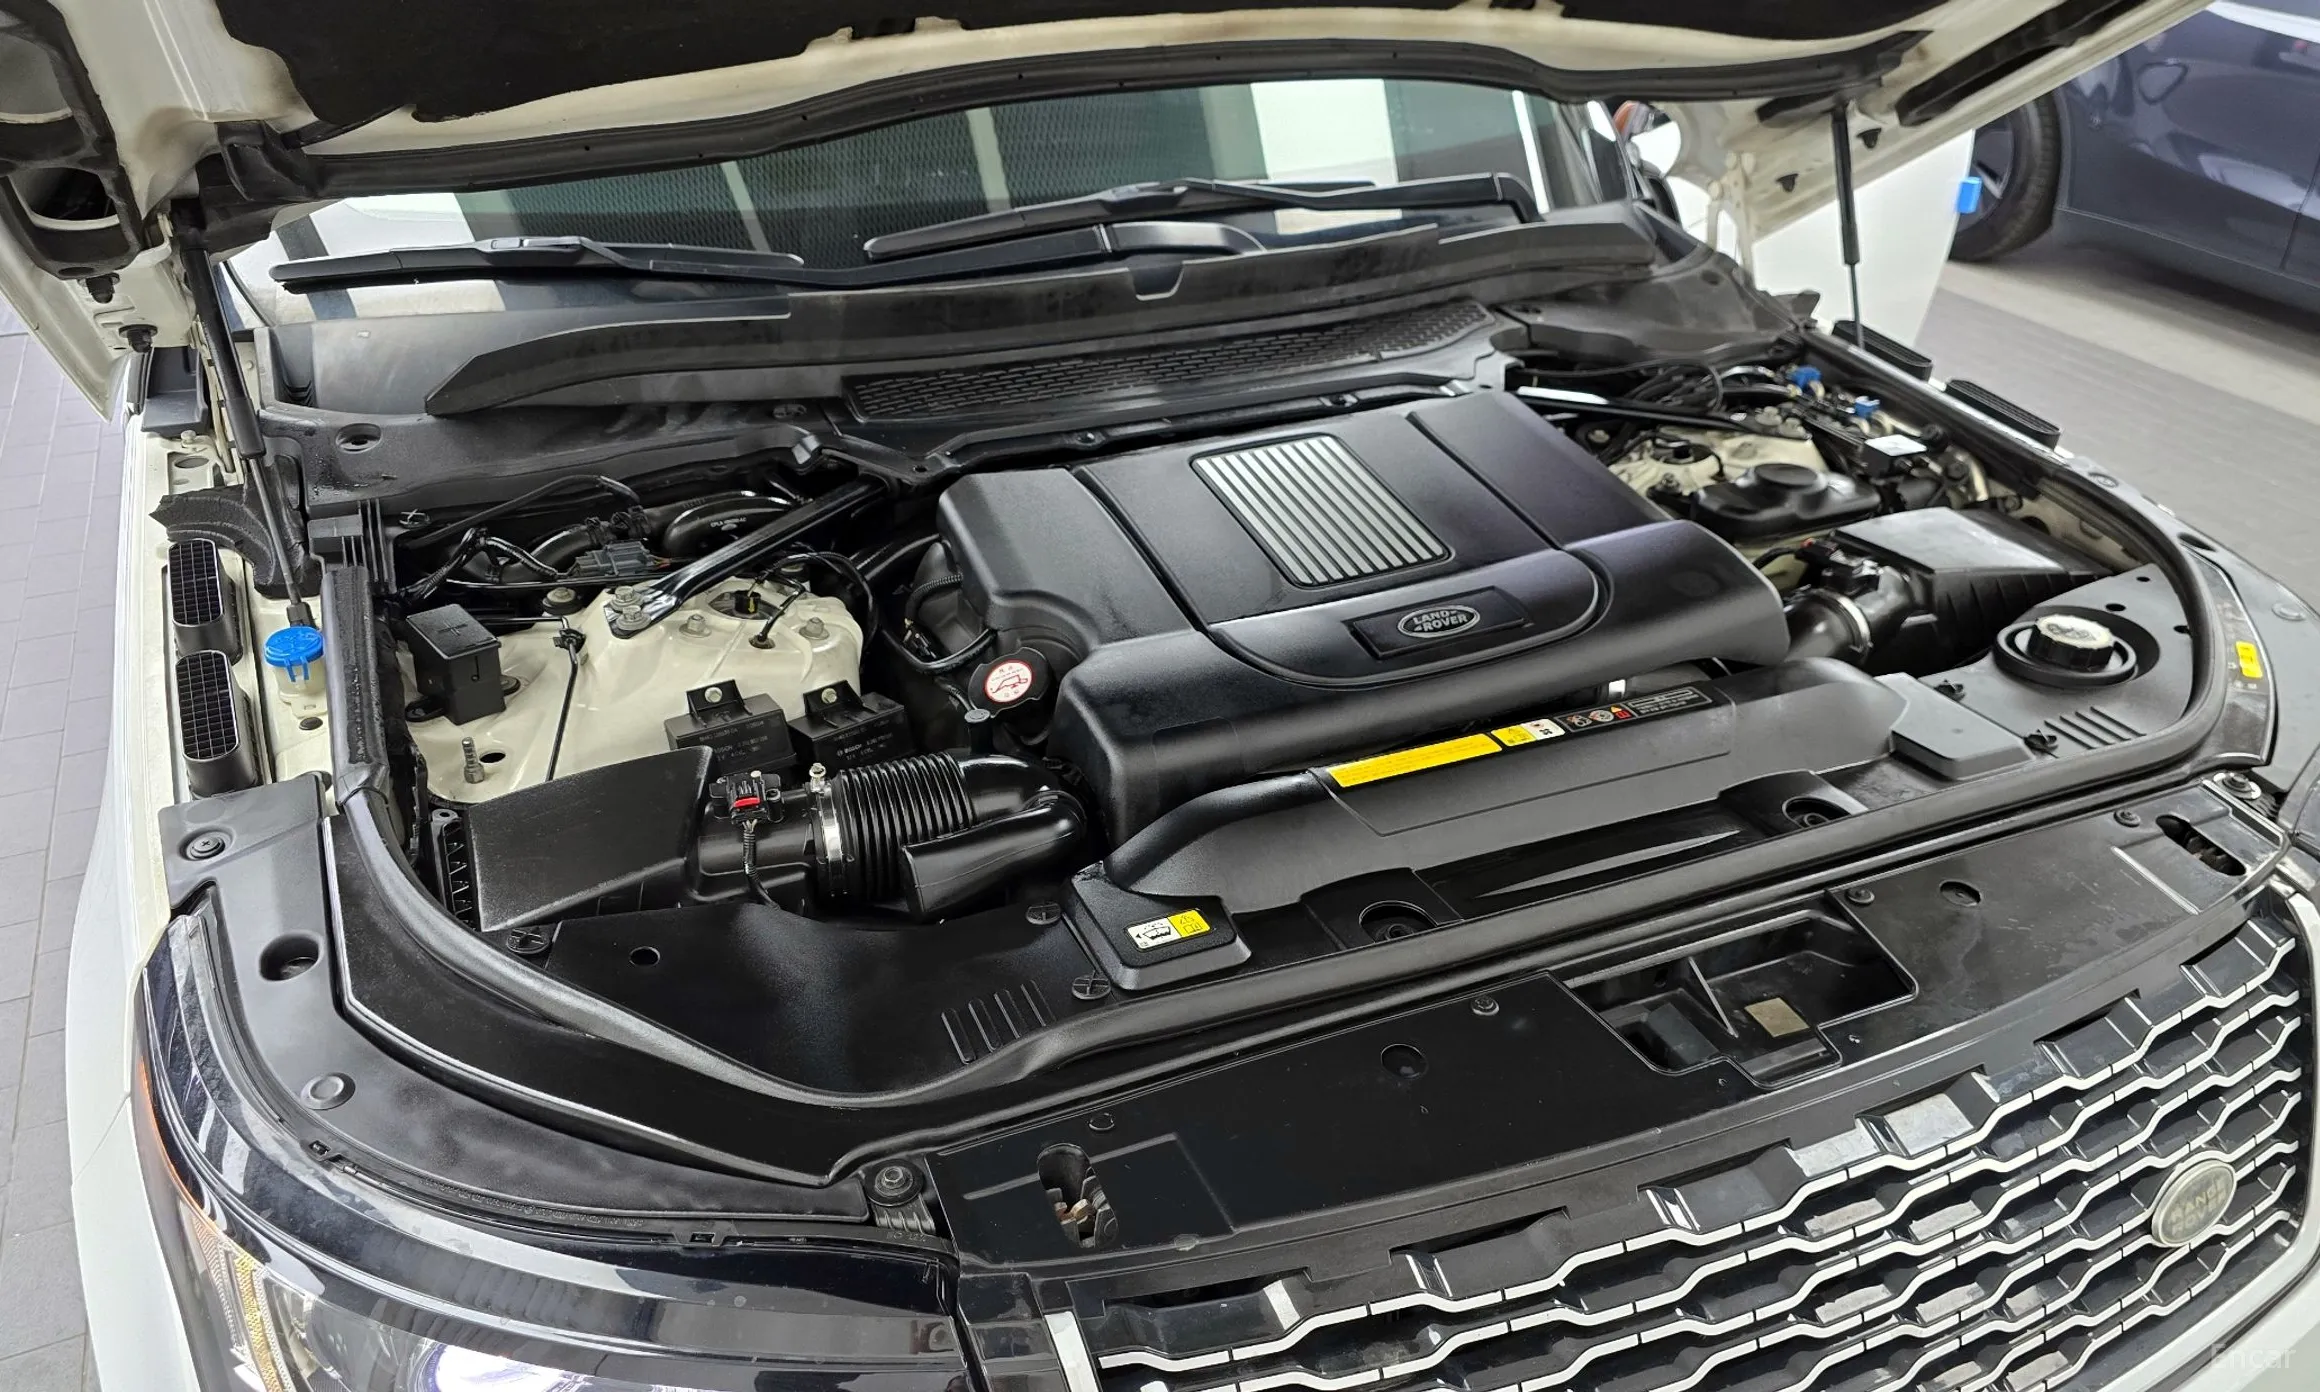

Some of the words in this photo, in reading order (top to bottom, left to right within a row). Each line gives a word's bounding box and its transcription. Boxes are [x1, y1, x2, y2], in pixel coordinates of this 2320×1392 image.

[1413, 609, 1450, 625] LAND
[1422, 613, 1468, 632] ROVER
[2167, 1177, 2227, 1224] RANGE
[2171, 1188, 2227, 1236] ROVER
